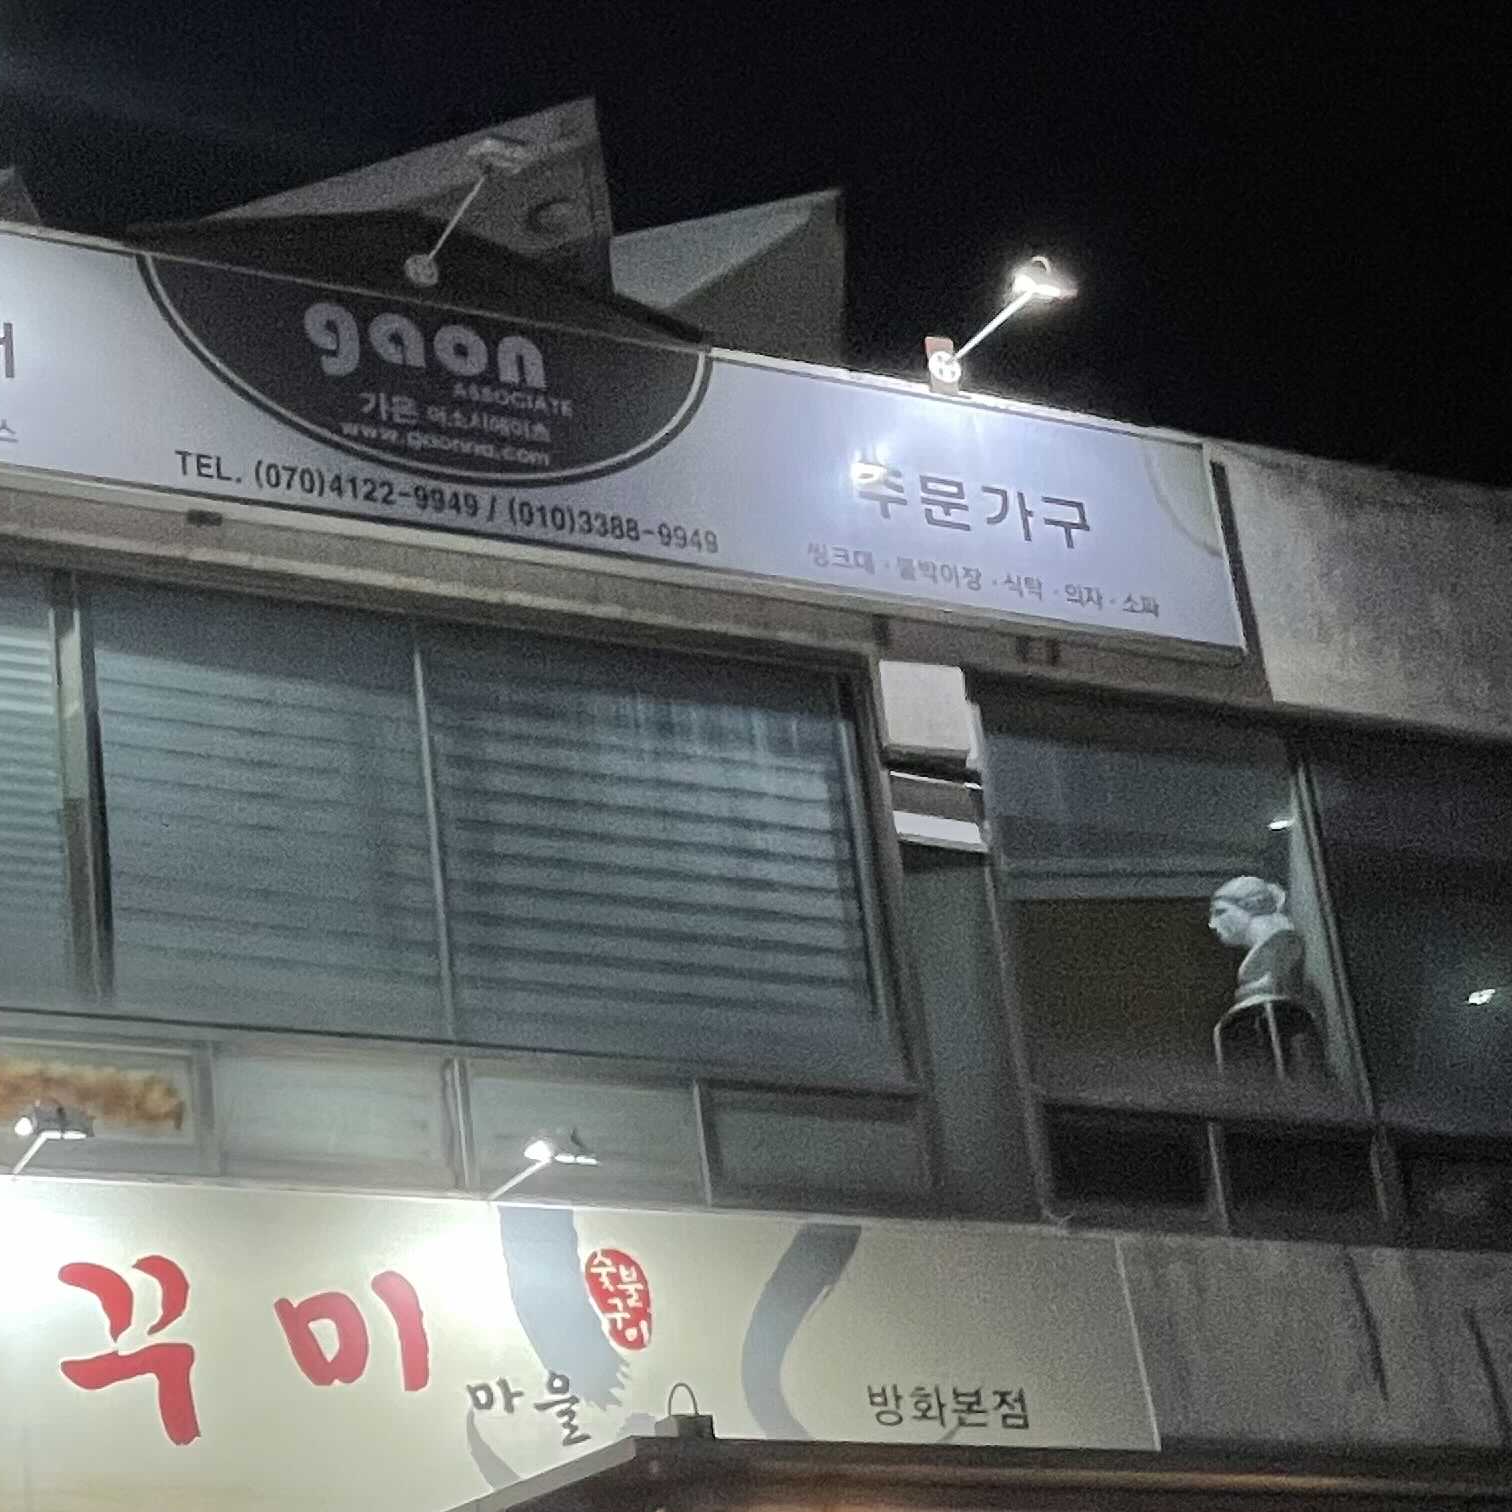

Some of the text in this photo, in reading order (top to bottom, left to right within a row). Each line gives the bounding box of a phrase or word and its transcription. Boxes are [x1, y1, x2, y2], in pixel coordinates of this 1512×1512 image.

[303, 301, 547, 390] gaon
[174, 450, 243, 483] TEL.
[855, 460, 1091, 549] 주문가구
[1064, 583, 1104, 611] 의자
[467, 1370, 592, 1447] 마을
[867, 1382, 1030, 1430] 방화본점
